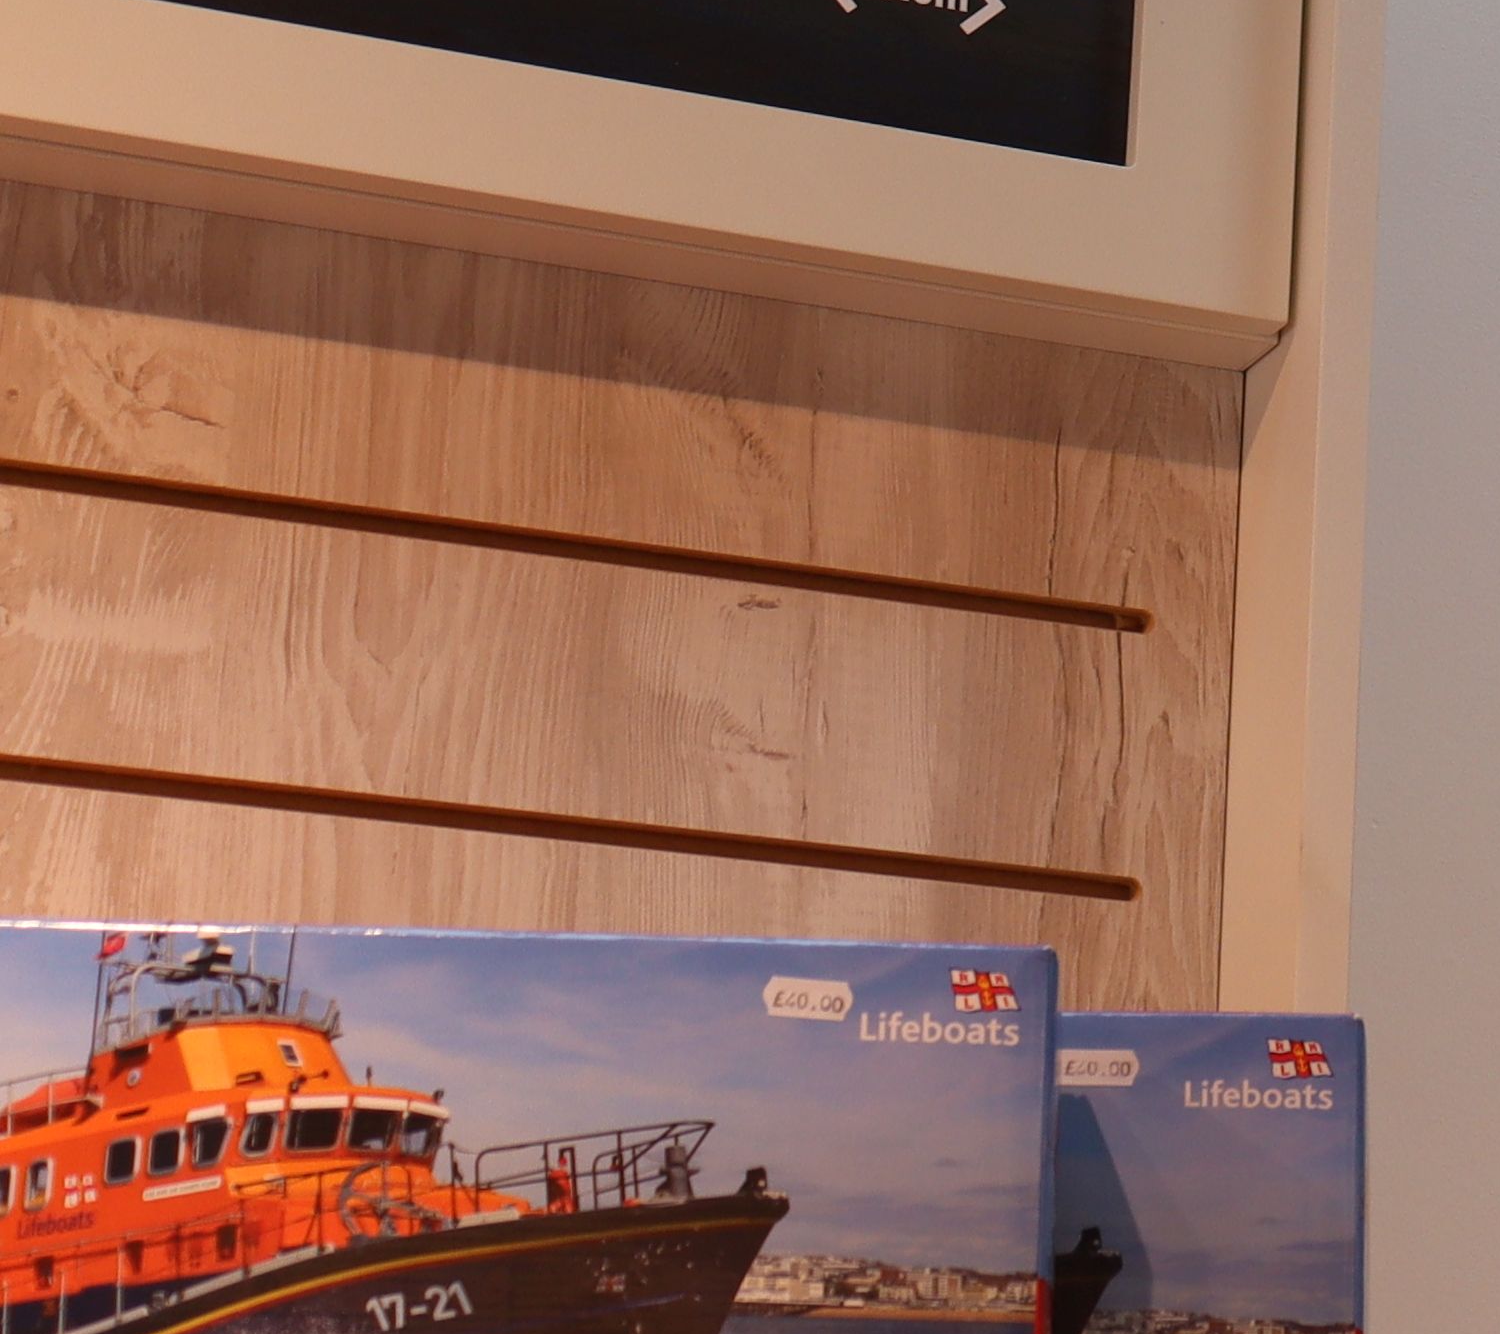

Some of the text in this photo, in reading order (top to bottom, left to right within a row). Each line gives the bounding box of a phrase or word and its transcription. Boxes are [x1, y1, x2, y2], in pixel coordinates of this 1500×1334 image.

[772, 988, 846, 1014] £40.00
[859, 1012, 1020, 1046] Lifeboats
[1184, 1080, 1334, 1111] Lifeboats
[16, 1211, 95, 1239] Lifeboats
[365, 1279, 473, 1332] 17-21
